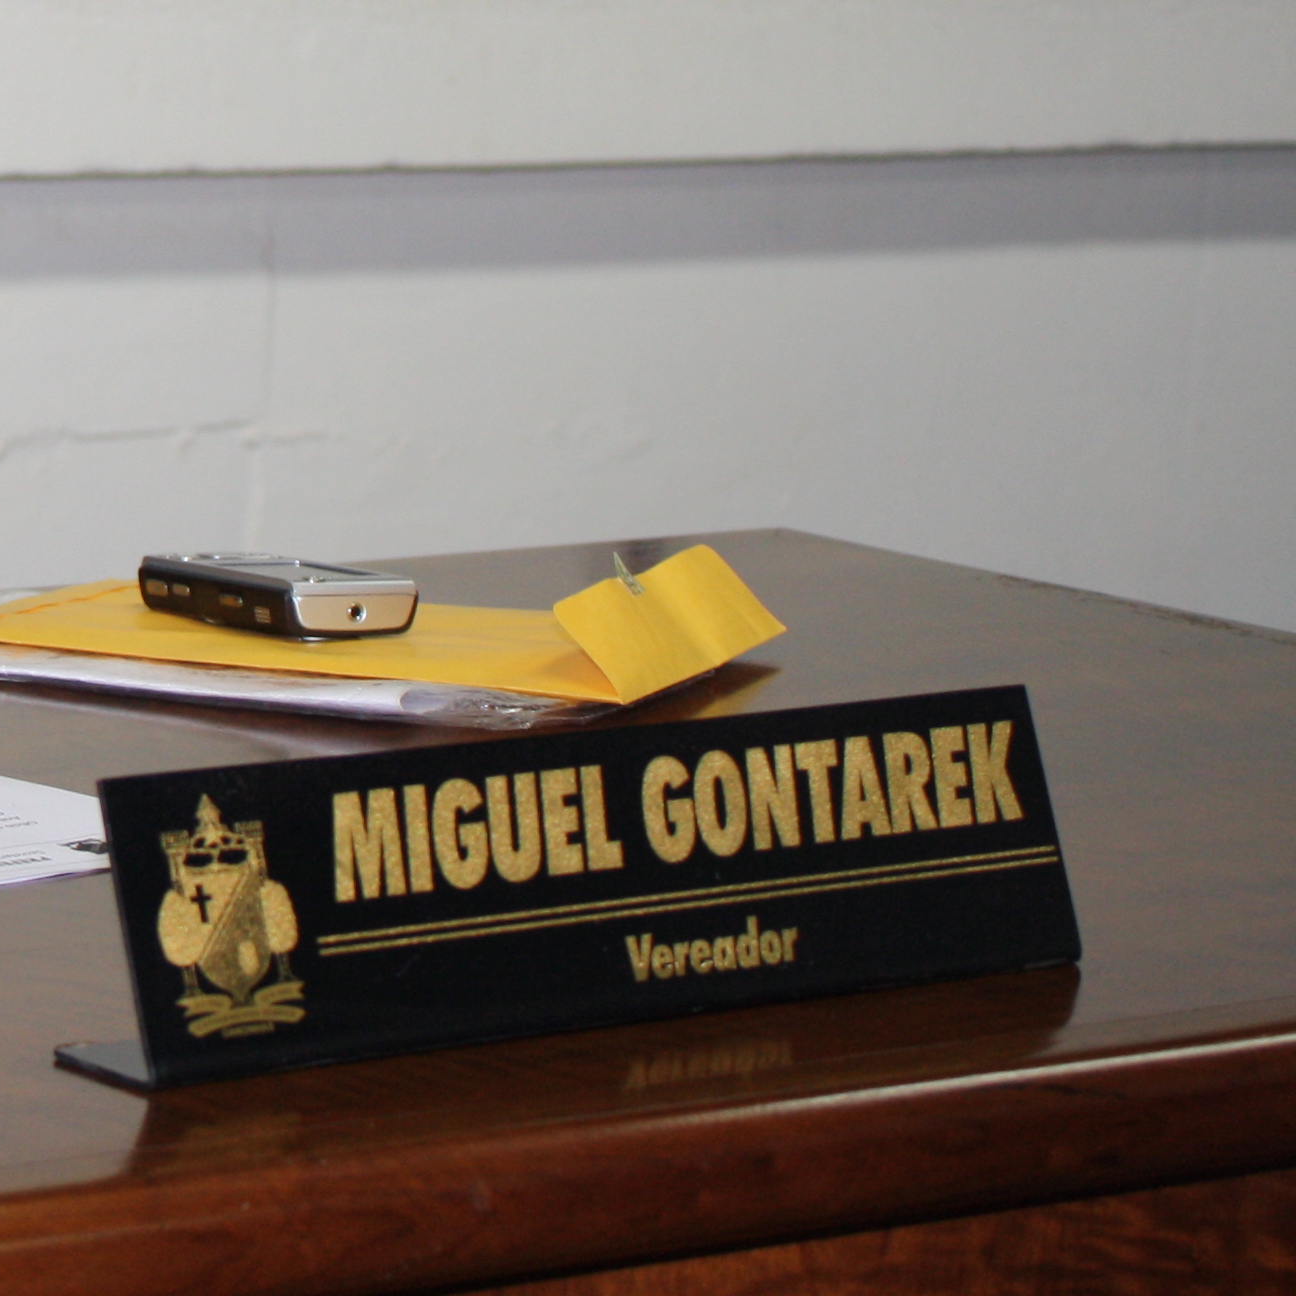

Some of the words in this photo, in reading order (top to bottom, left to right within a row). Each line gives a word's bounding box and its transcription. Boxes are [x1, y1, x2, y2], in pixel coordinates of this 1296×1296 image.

[333, 764, 624, 903] MIGUEL
[641, 719, 1025, 864] GONTAREK
[625, 915, 798, 982] Vereador
